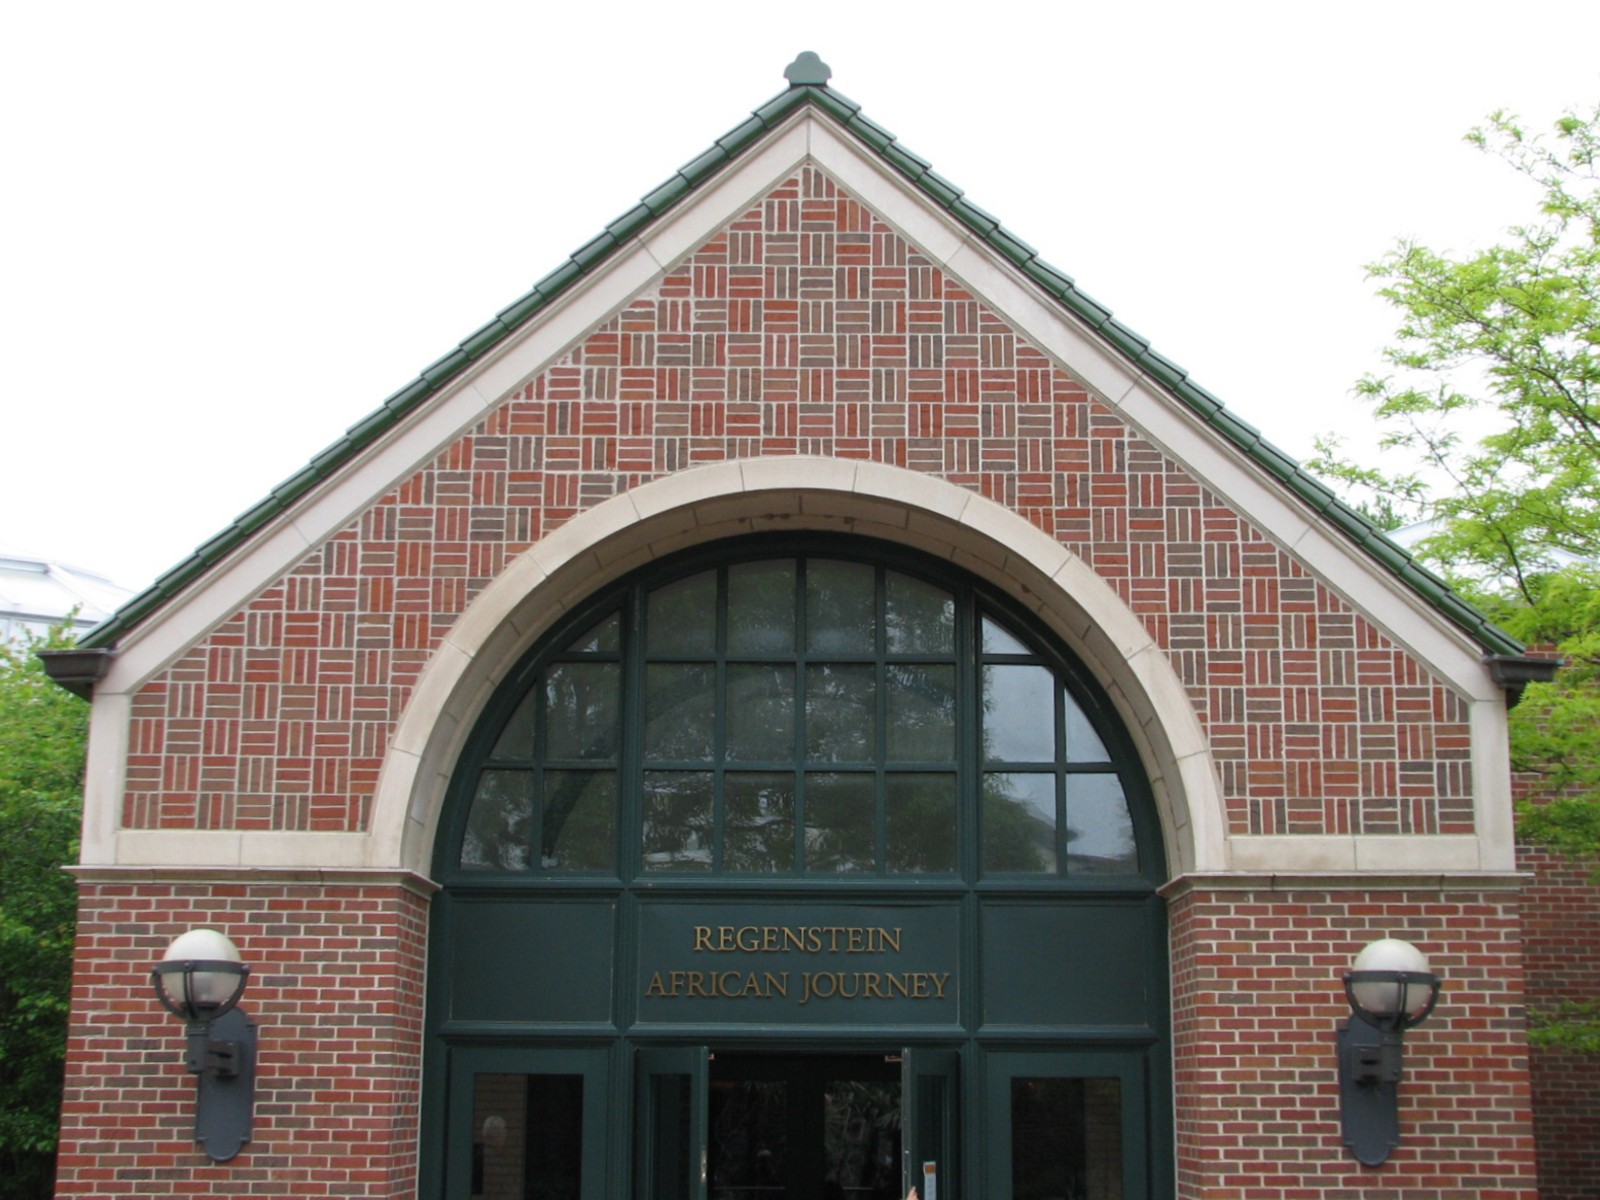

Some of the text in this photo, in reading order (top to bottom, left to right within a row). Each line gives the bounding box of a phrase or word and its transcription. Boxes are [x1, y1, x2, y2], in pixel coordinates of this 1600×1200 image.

[693, 926, 903, 953] REGENSTEIN
[645, 971, 951, 1004] AFRICAN JOURNEY
